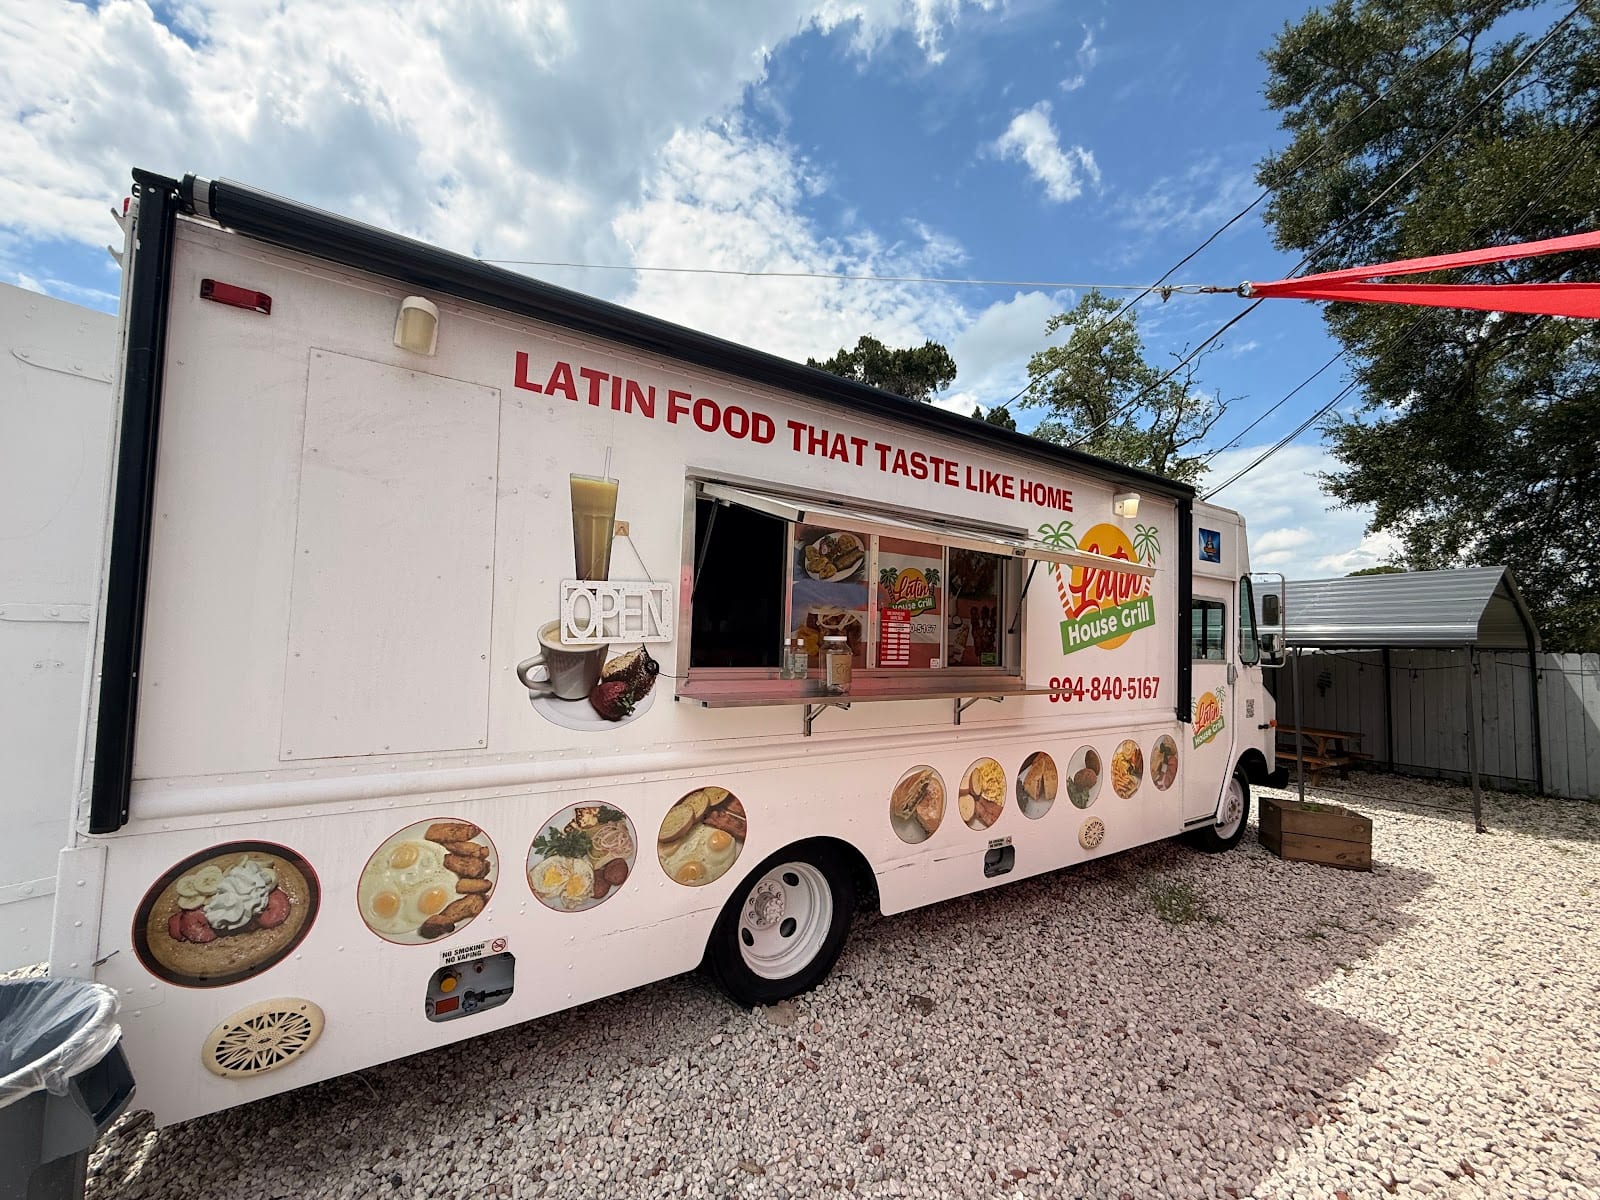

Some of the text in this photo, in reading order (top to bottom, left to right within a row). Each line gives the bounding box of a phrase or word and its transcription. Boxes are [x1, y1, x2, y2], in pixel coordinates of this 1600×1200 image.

[514, 351, 1073, 512] LATIN FOOD THAT TASTE LIKE HOME
[894, 576, 929, 603] Latin
[1069, 543, 1143, 618] Latin
[566, 588, 668, 638] OPEN
[917, 597, 933, 608] Grill
[1068, 601, 1150, 646] House Grill
[1049, 676, 1160, 702] 904-840-5167
[1195, 700, 1219, 735] Latin
[442, 943, 485, 959] NO SMOKING
[445, 950, 482, 964] NO VAPING
